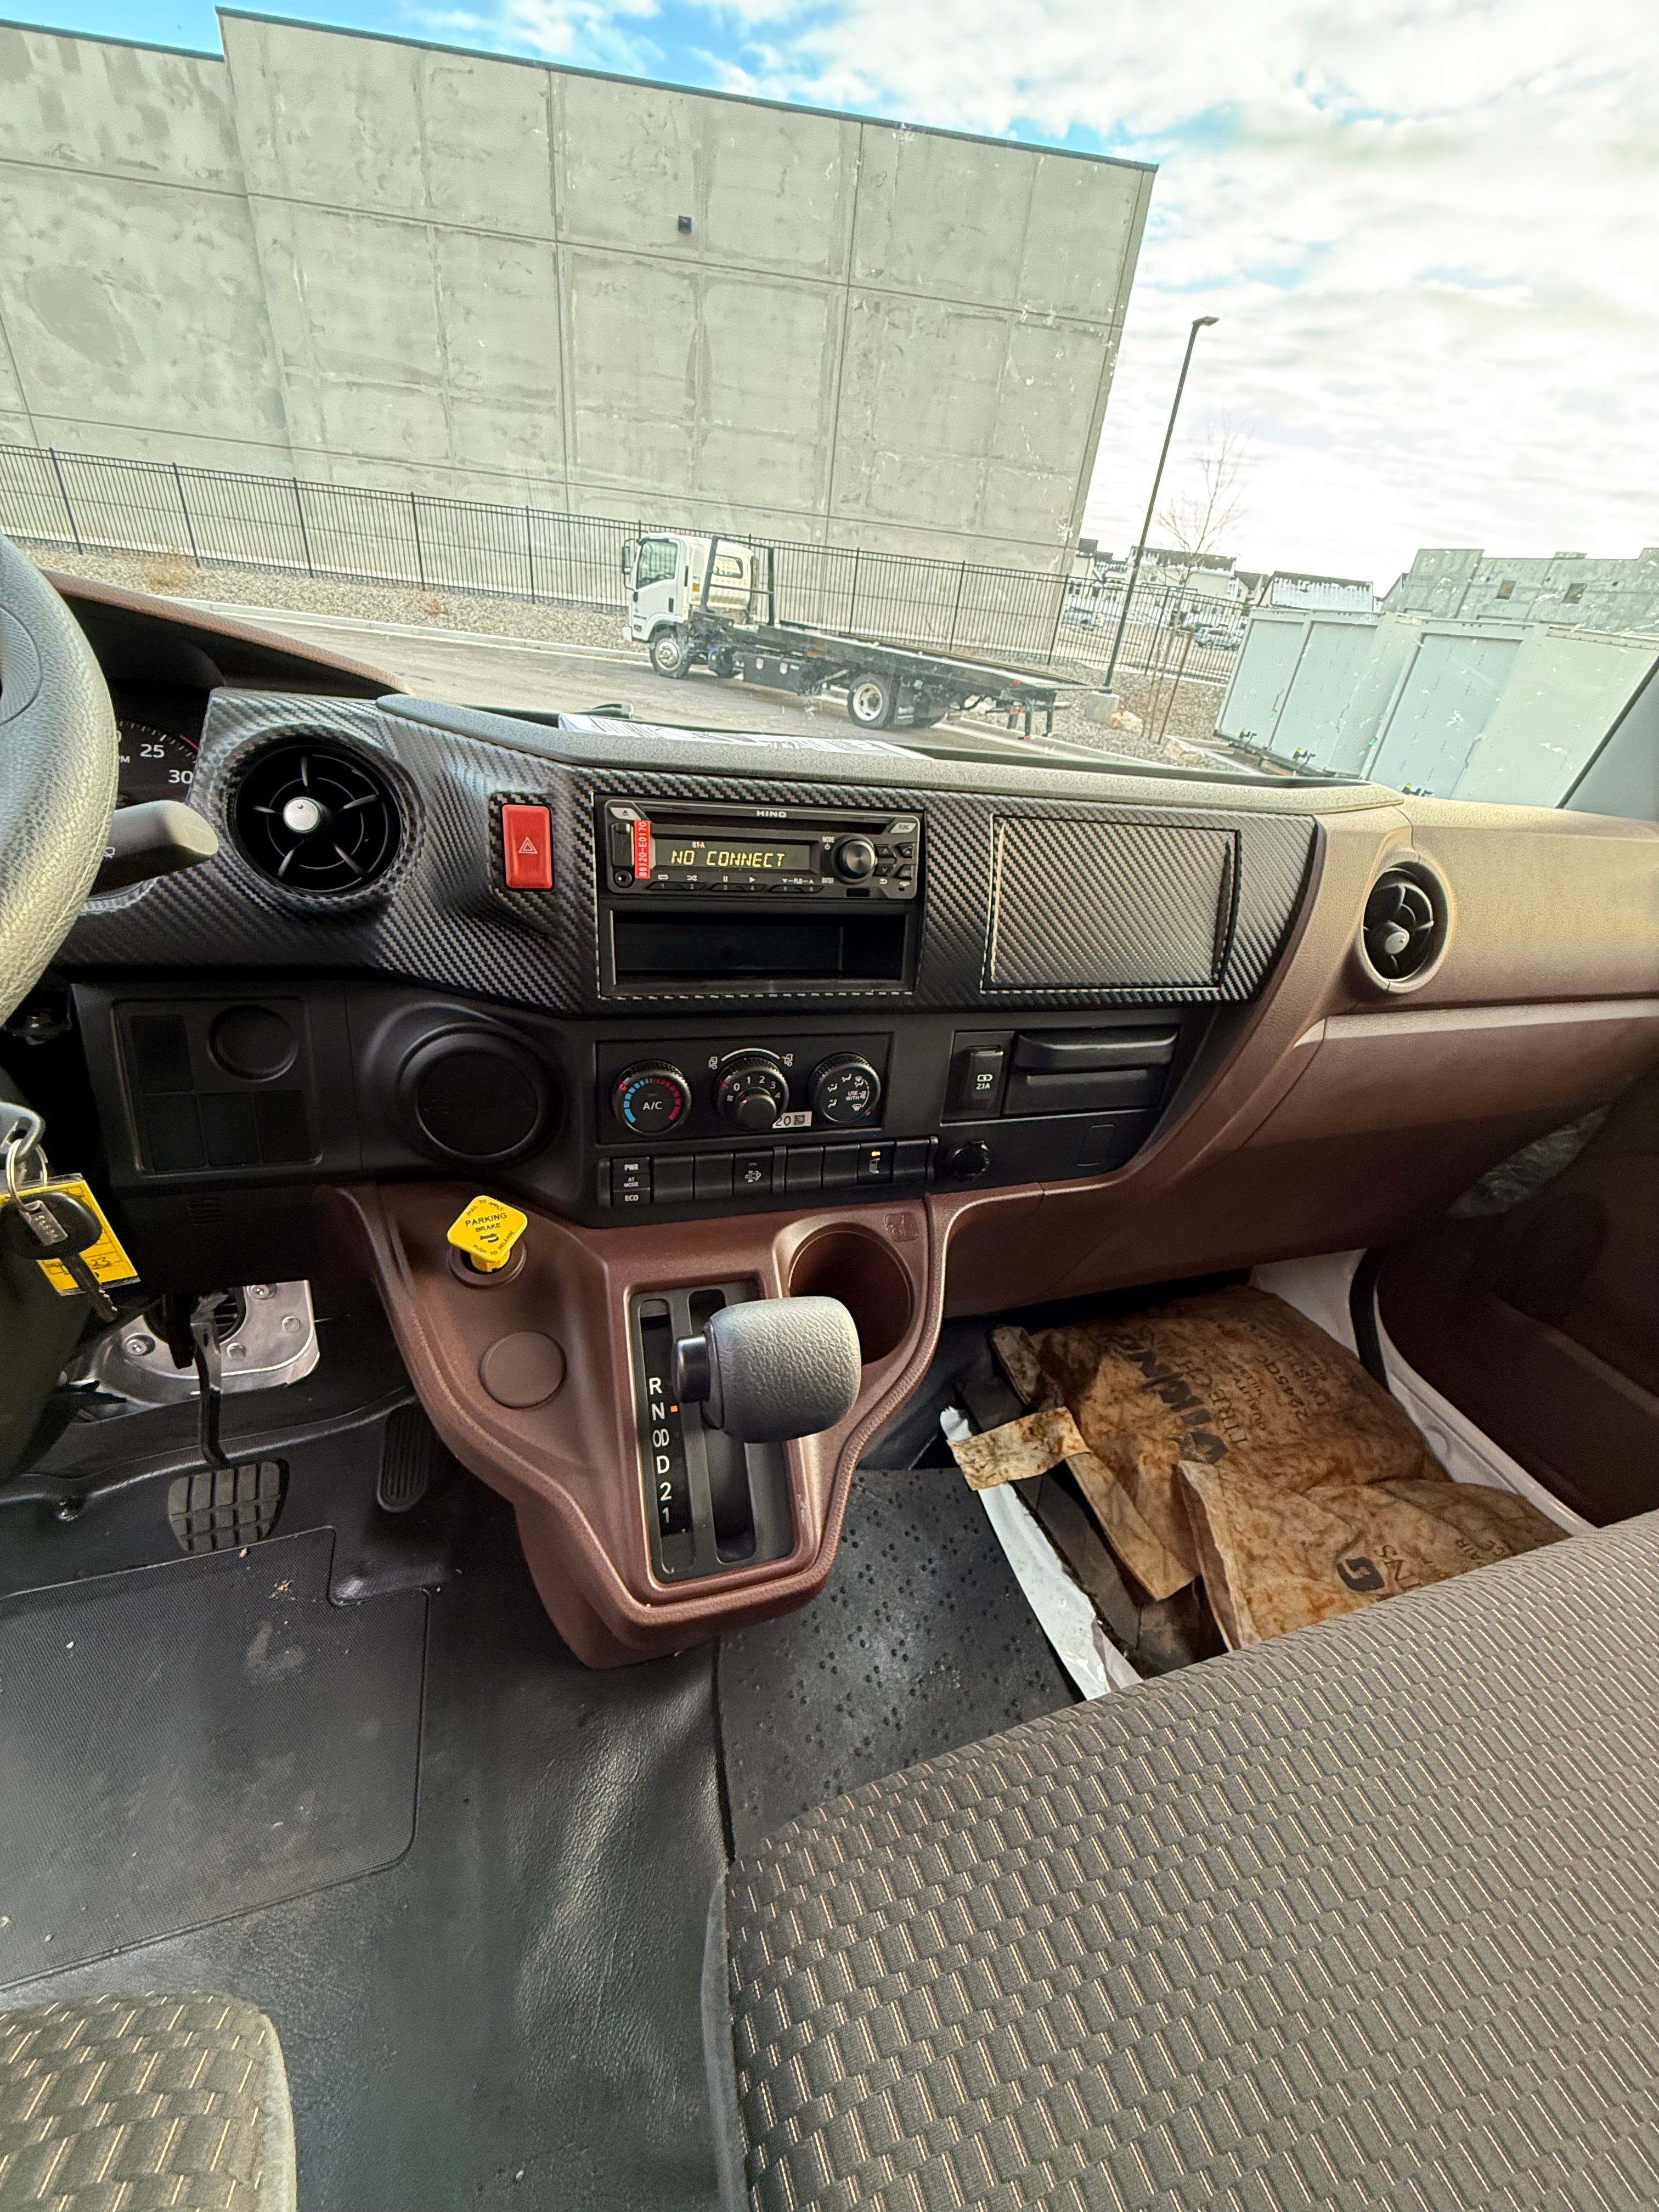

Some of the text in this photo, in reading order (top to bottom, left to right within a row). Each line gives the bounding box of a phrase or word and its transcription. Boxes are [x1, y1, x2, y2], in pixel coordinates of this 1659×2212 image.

[140, 743, 165, 758] 25
[168, 769, 193, 785] 30
[756, 810, 787, 818] HINO
[638, 822, 647, 877] 86120-E0170
[671, 850, 785, 867] NO CONNECT
[733, 1083, 740, 1091] 0
[747, 1076, 751, 1085] 1
[642, 1101, 662, 1111] A/C
[775, 1115, 791, 1126] 20
[465, 1212, 507, 1227] PARKING
[475, 1223, 501, 1232] BRAKE
[648, 1377, 663, 1395] R
[651, 1402, 665, 1420] N
[1208, 1389, 1249, 1447] TIRE
[652, 1429, 669, 1448] OD
[656, 1455, 670, 1474] D
[659, 1482, 672, 1501] 2
[662, 1507, 669, 1523] 1
